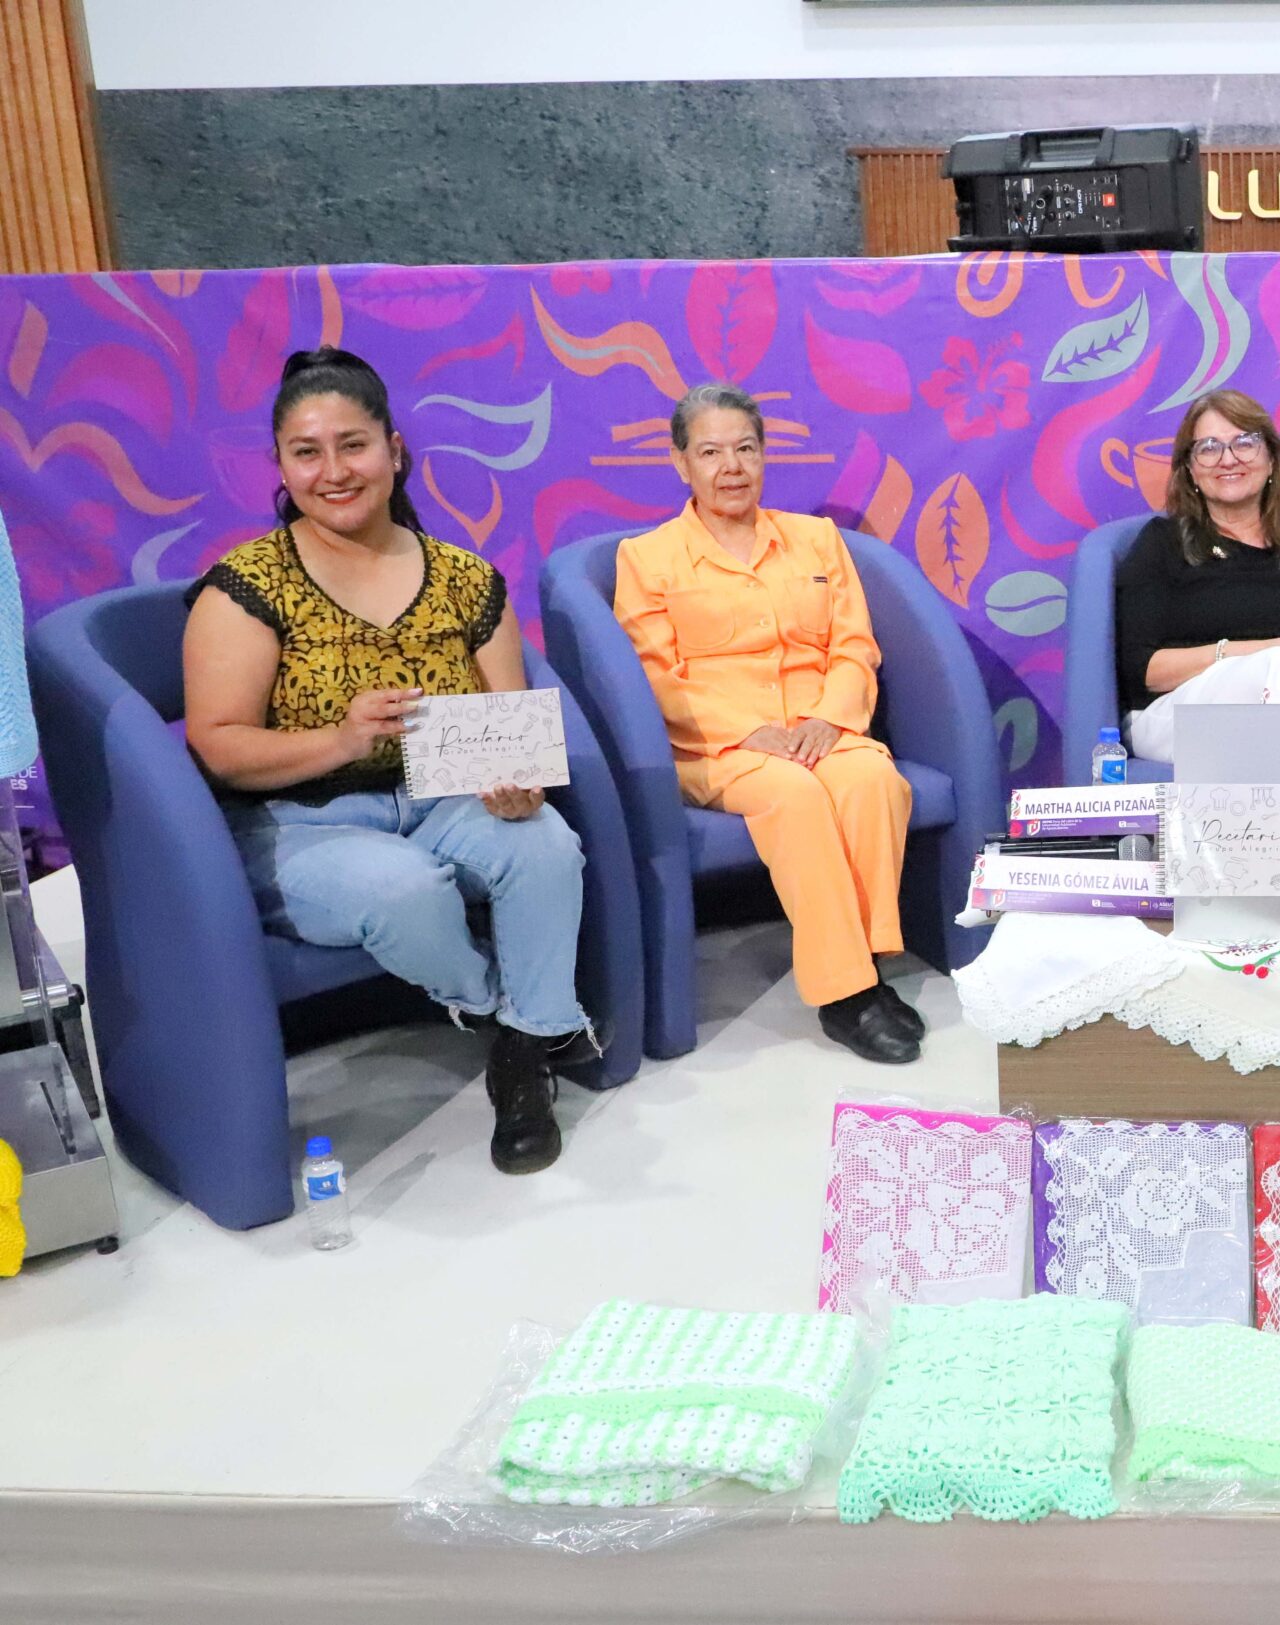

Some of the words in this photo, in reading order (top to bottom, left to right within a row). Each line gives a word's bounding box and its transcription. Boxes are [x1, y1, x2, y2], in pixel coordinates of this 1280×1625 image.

[434, 724, 528, 758] Recetario
[1025, 801, 1071, 816] MARTHA
[1075, 799, 1111, 814] ALICIA
[1114, 796, 1156, 812] PIZAÑA
[1008, 871, 1060, 887] YESENIA
[1063, 871, 1109, 890] GÓMEZ
[1112, 873, 1149, 892] ÁVILA
